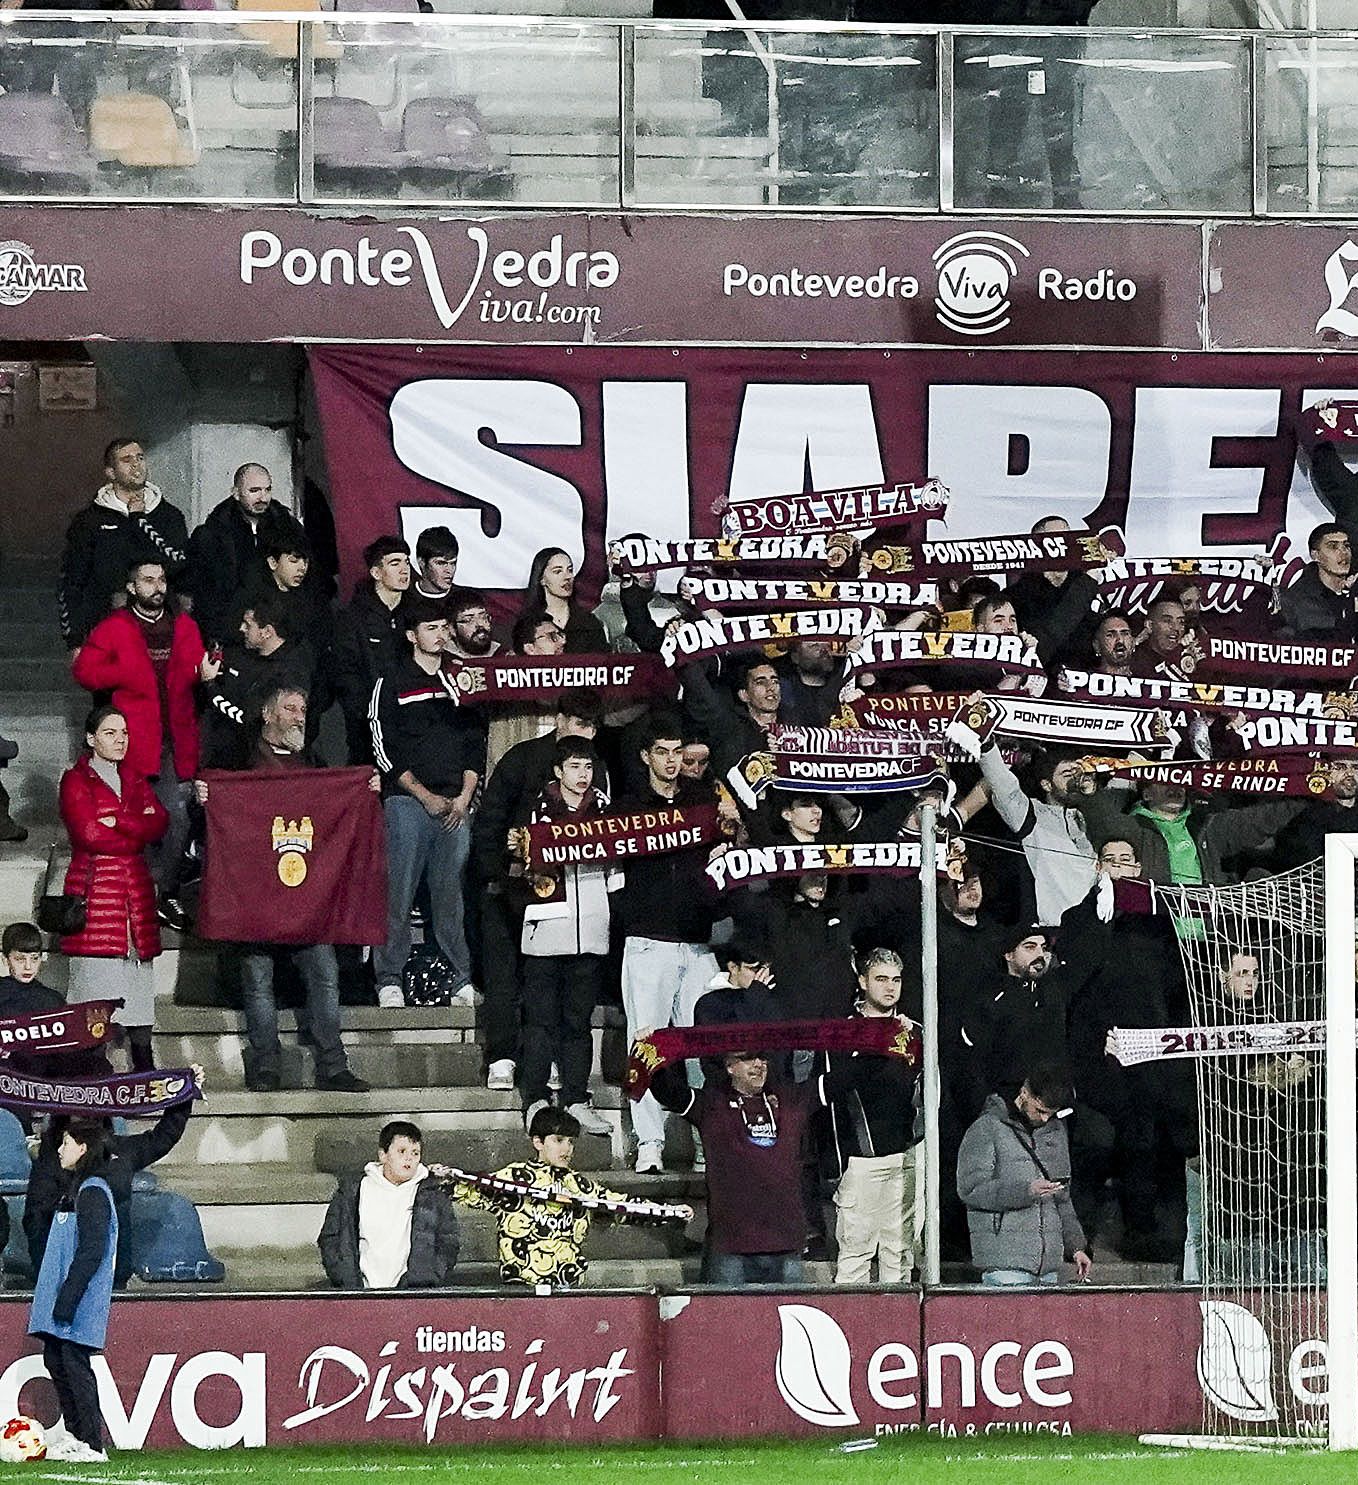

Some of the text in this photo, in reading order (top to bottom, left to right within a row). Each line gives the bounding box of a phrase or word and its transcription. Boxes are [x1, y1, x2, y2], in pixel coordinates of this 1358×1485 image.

[723, 264, 1137, 300] Pontevedra Viva Radio
[922, 537, 1068, 563] PONTEVEDRA CF
[972, 561, 1025, 571] DESDE 1941
[685, 578, 938, 605] PONTEVEDRA
[660, 607, 887, 667] PONTEVEDRA
[1210, 639, 1354, 667] PONTEVEDRA CF
[495, 666, 634, 688] PONTEVEDRA CF
[1063, 668, 1325, 718] PONTEVEDRA
[863, 712, 921, 733] NUNCA
[928, 717, 950, 734] SE
[1013, 711, 1125, 731] PONTEVEDRA CF
[1130, 767, 1289, 792] NUNCA SE RINDE
[551, 808, 685, 840] PONTEVEDRA
[542, 827, 702, 863] NUNCA SE RINDE
[1, 1021, 65, 1044] ROELO
[0, 1075, 114, 1105] ONTEVEDRA
[416, 1326, 505, 1353] tiendas
[868, 1341, 1073, 1409] ence
[282, 1339, 637, 1444] Dispaint
